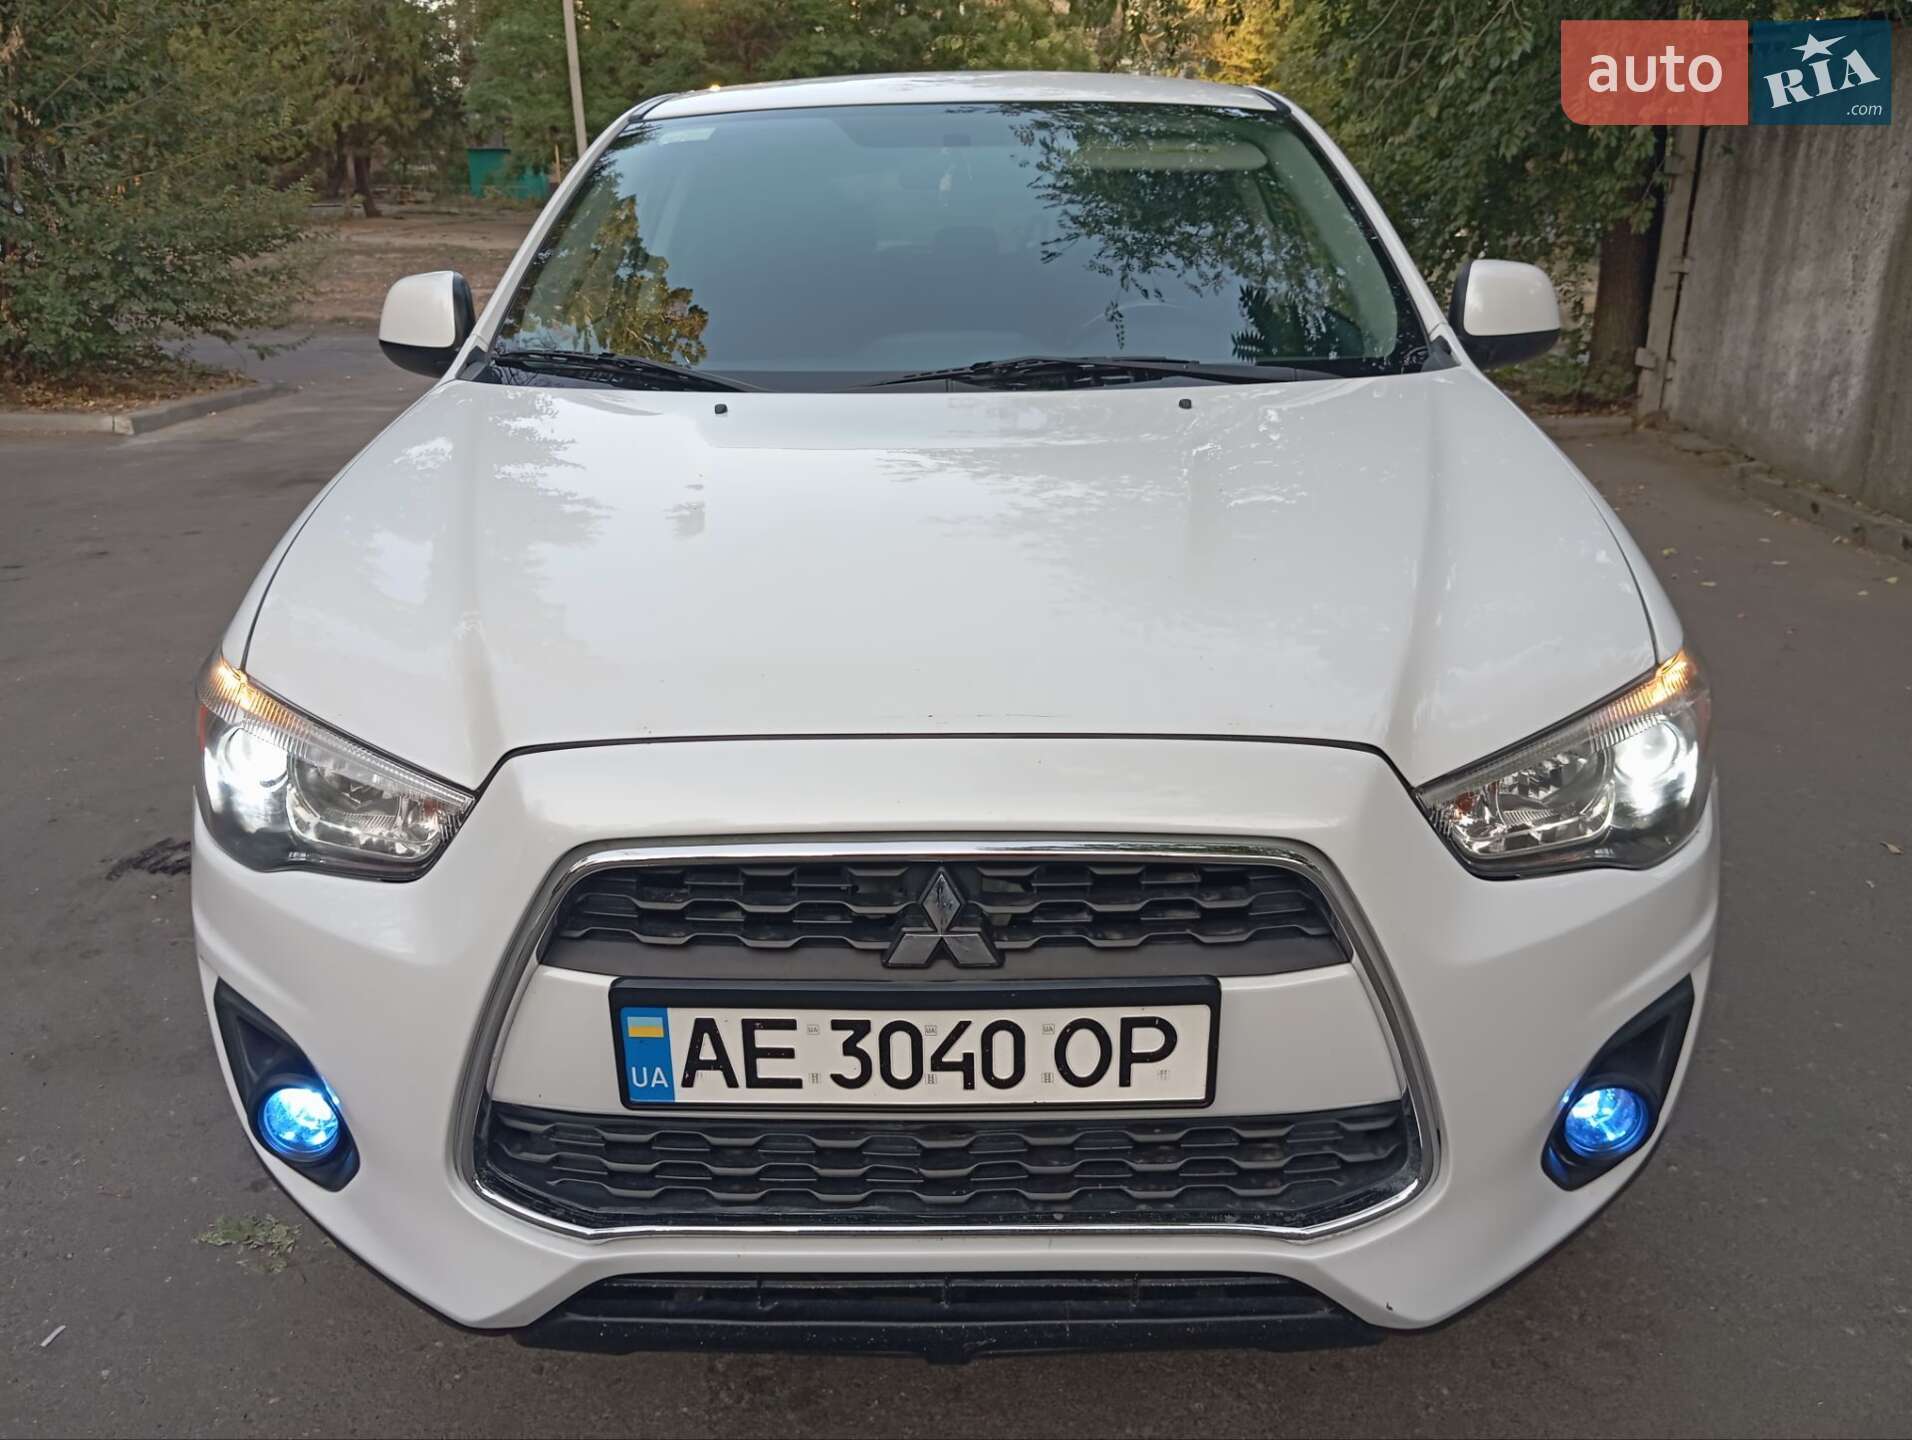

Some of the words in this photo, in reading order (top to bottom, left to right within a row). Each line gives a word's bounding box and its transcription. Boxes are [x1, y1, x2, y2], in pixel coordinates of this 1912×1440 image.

[631, 1066, 669, 1088] UA
[681, 1017, 803, 1089] AE
[830, 1019, 1026, 1090] 3040
[1054, 1016, 1177, 1088] OP
